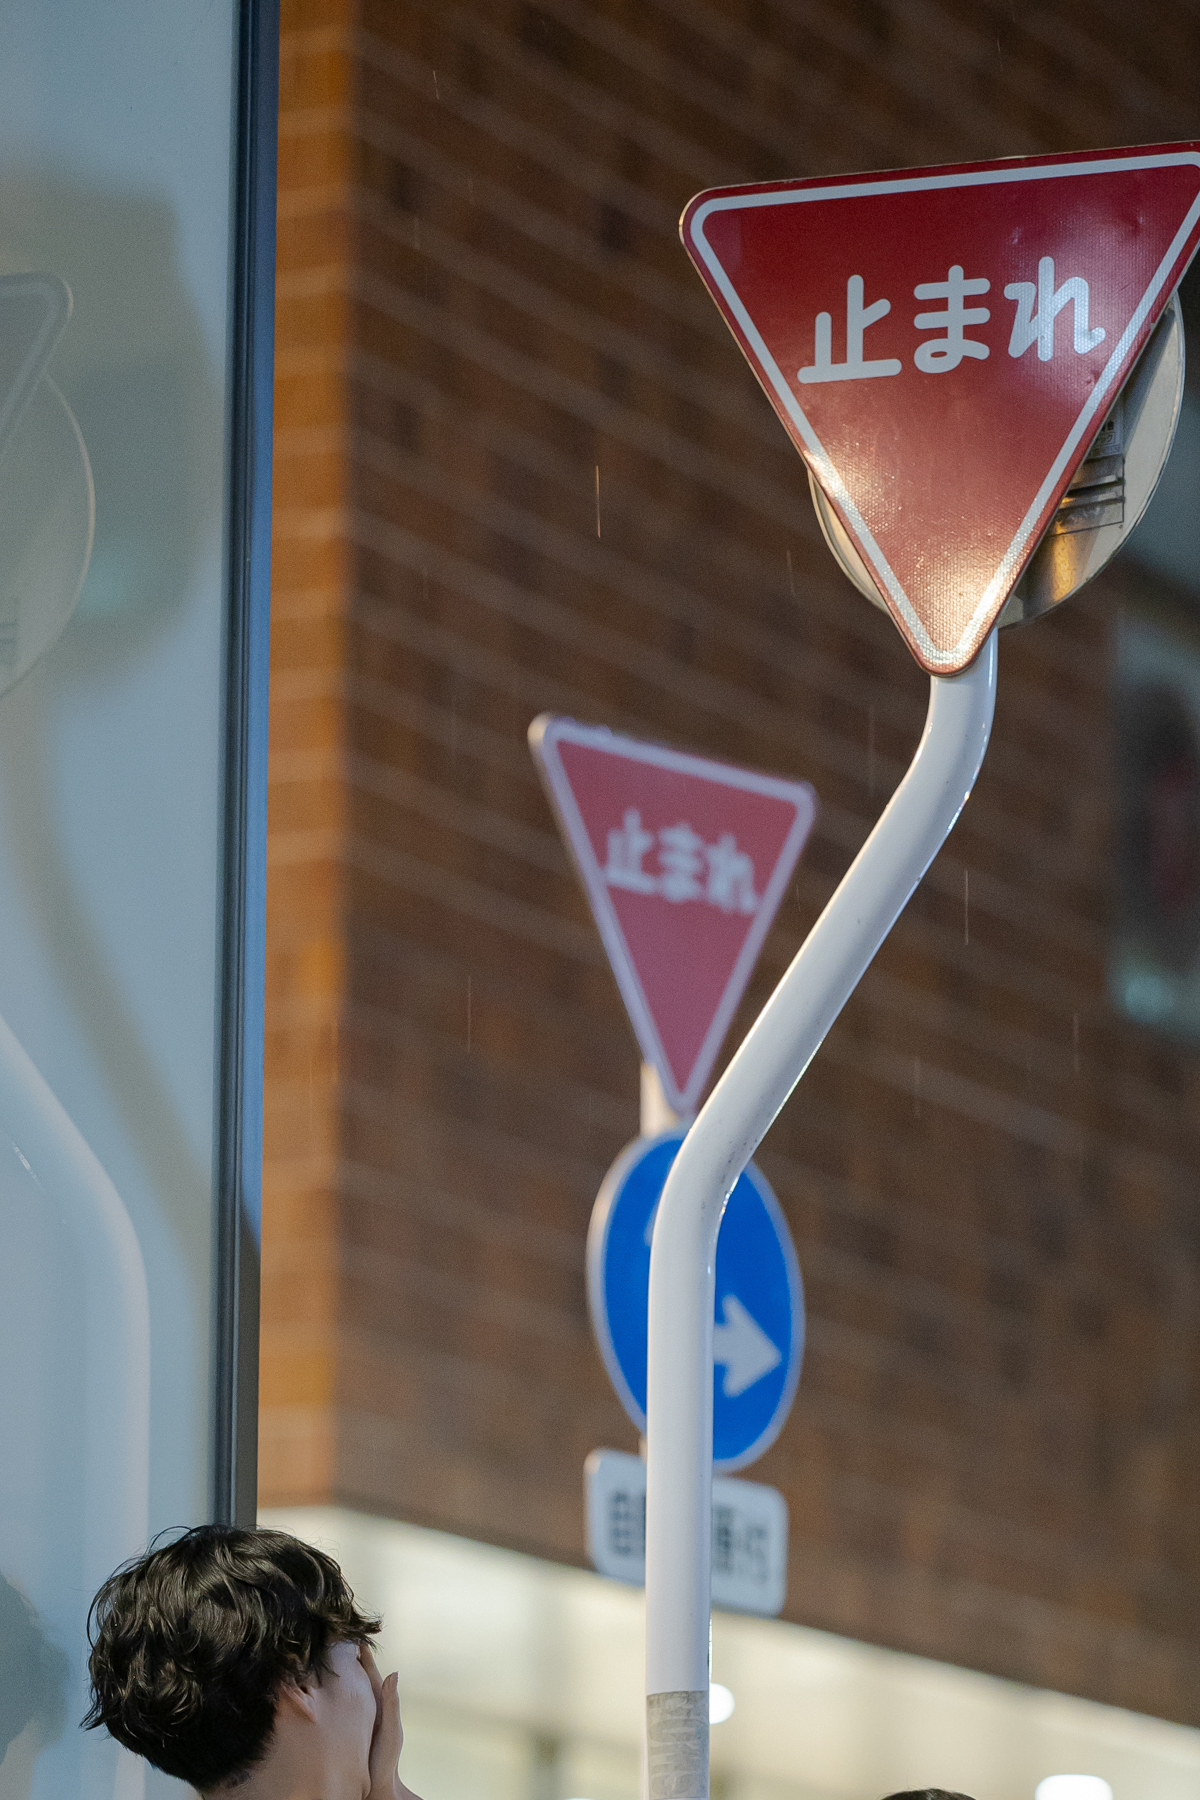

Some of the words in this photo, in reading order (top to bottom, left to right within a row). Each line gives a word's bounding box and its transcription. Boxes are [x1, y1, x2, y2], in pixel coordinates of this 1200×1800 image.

[797, 256, 1106, 384] 止まれ
[603, 807, 758, 914] 止まれ
